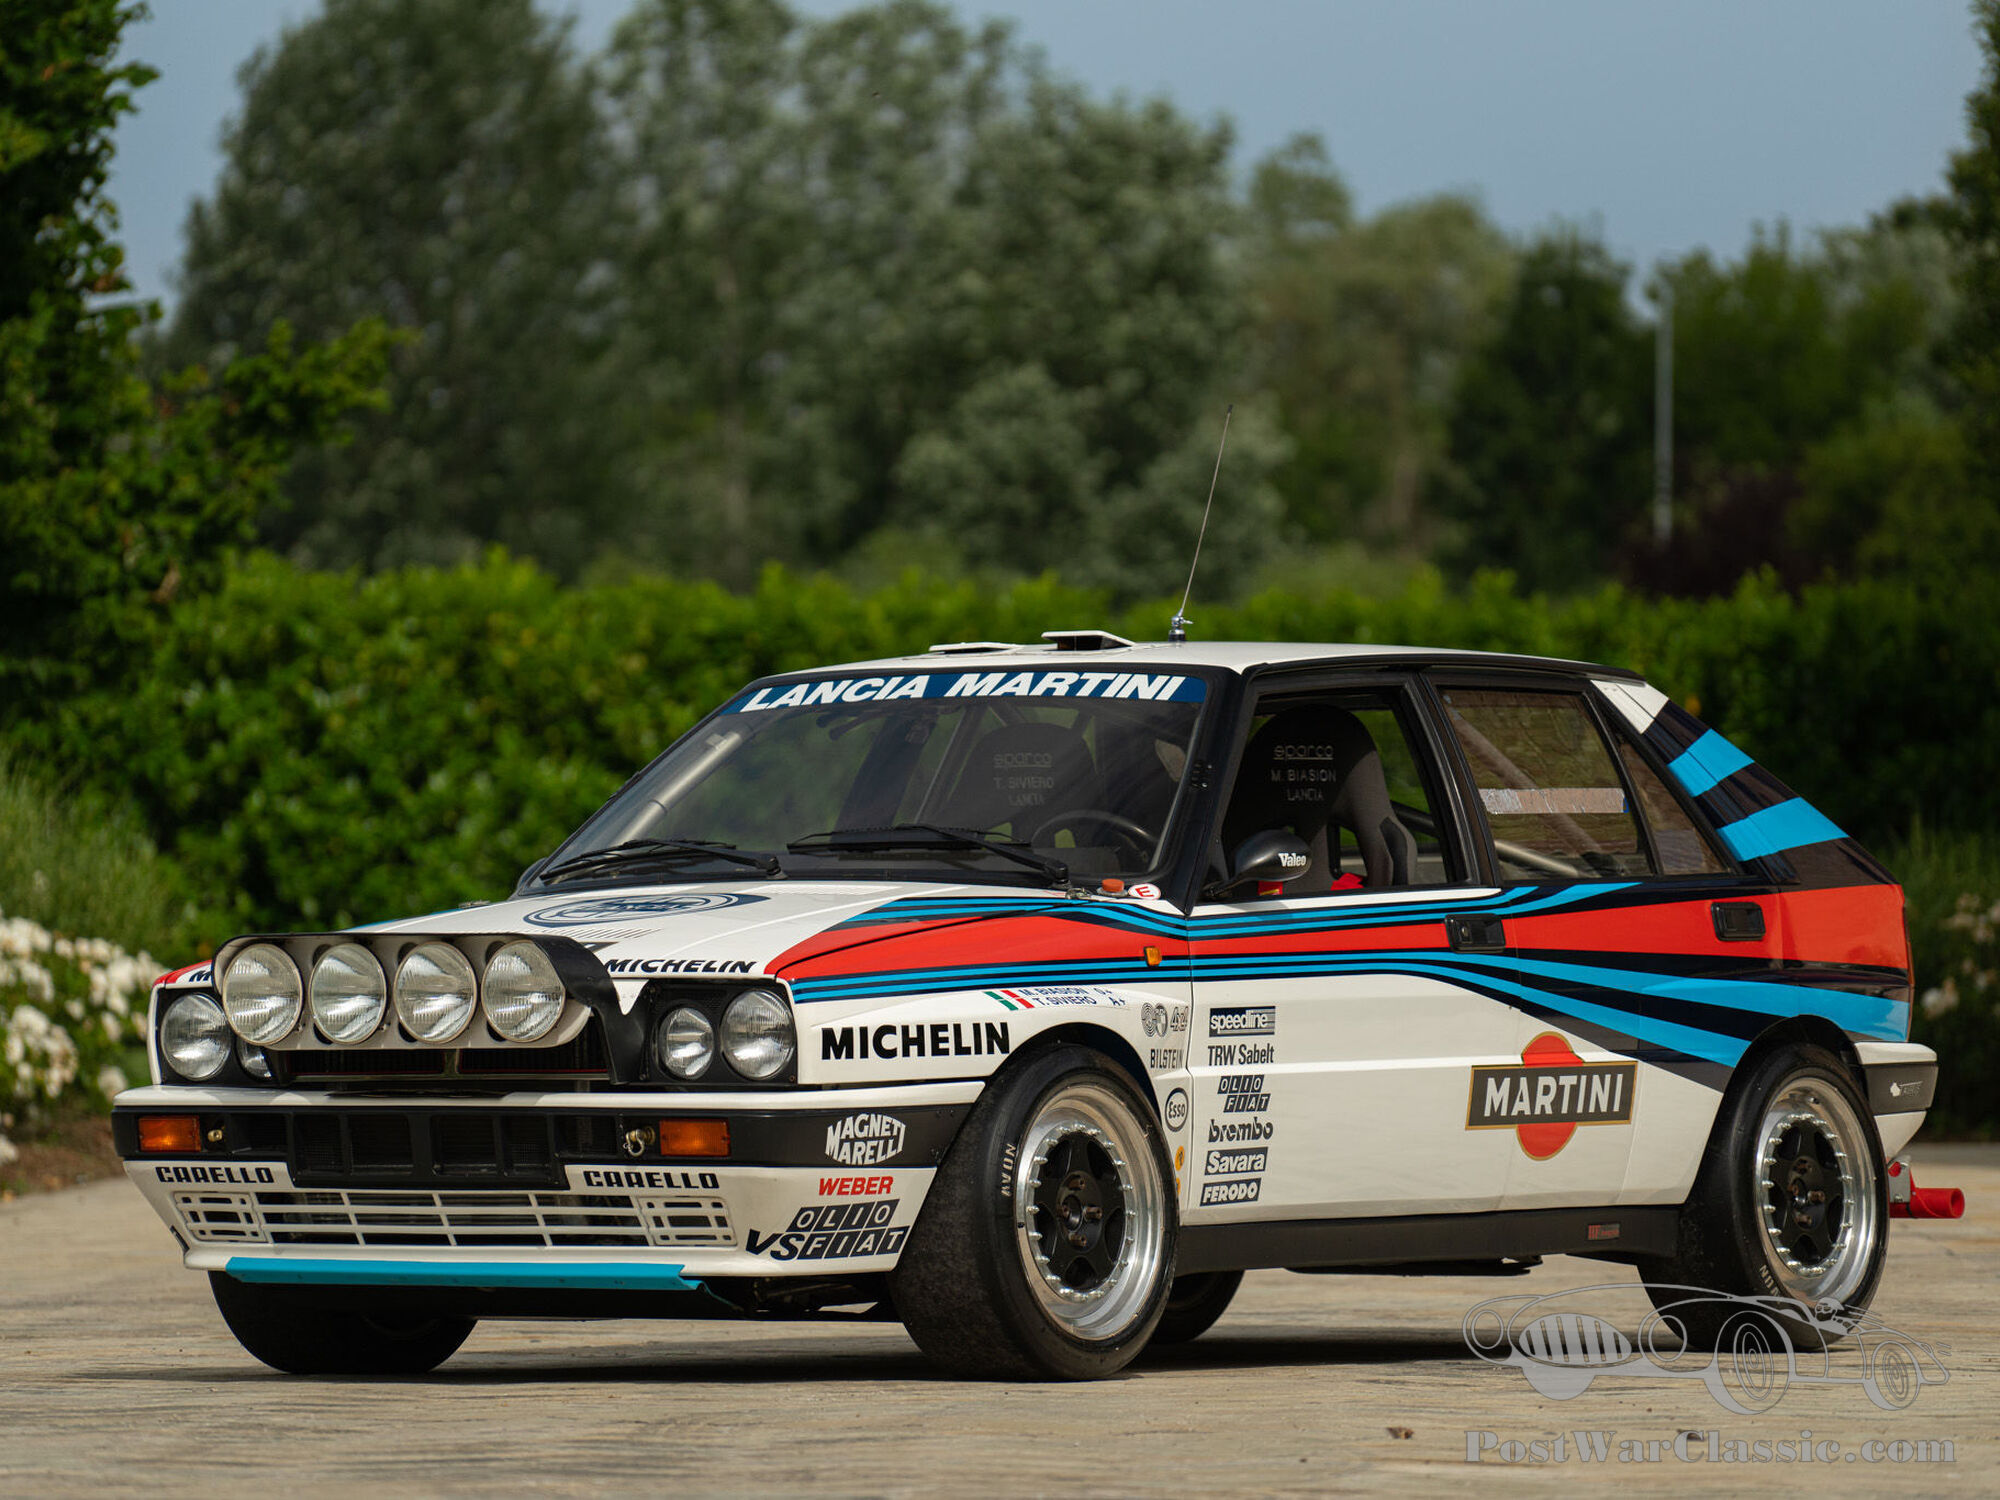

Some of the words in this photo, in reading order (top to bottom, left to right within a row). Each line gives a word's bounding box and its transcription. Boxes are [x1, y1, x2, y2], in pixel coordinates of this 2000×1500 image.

[740, 675, 930, 712] LANCIA
[943, 672, 1187, 701] MARTINI
[1273, 745, 1335, 761] sparco
[1287, 768, 1337, 782] BIASION
[1278, 852, 1307, 867] Valeo
[1134, 885, 1154, 898] E
[604, 959, 756, 974] MICHELIN
[1046, 996, 1097, 1006] SIVIERO
[1210, 1009, 1270, 1034] speedline
[822, 1022, 1010, 1060] MICHELIN
[1150, 1048, 1184, 1069] BILSTEIN
[1208, 1045, 1236, 1066] TRW
[1238, 1043, 1274, 1064] Sabelt
[1219, 1076, 1262, 1093] OLIO
[1484, 1074, 1623, 1117] MARTINI
[1168, 1101, 1186, 1119] Esso
[1225, 1095, 1270, 1111] FIAT
[825, 1113, 906, 1150] MAGNETI
[1208, 1117, 1273, 1142] brembo
[1001, 1143, 1017, 1197] AVON
[1207, 1151, 1265, 1173] Savara
[818, 1176, 894, 1196] WEBER
[1203, 1181, 1259, 1203] FERODO
[795, 1203, 893, 1229] OLIO
[746, 1229, 805, 1261] VS
[802, 1229, 906, 1257] FIAT
